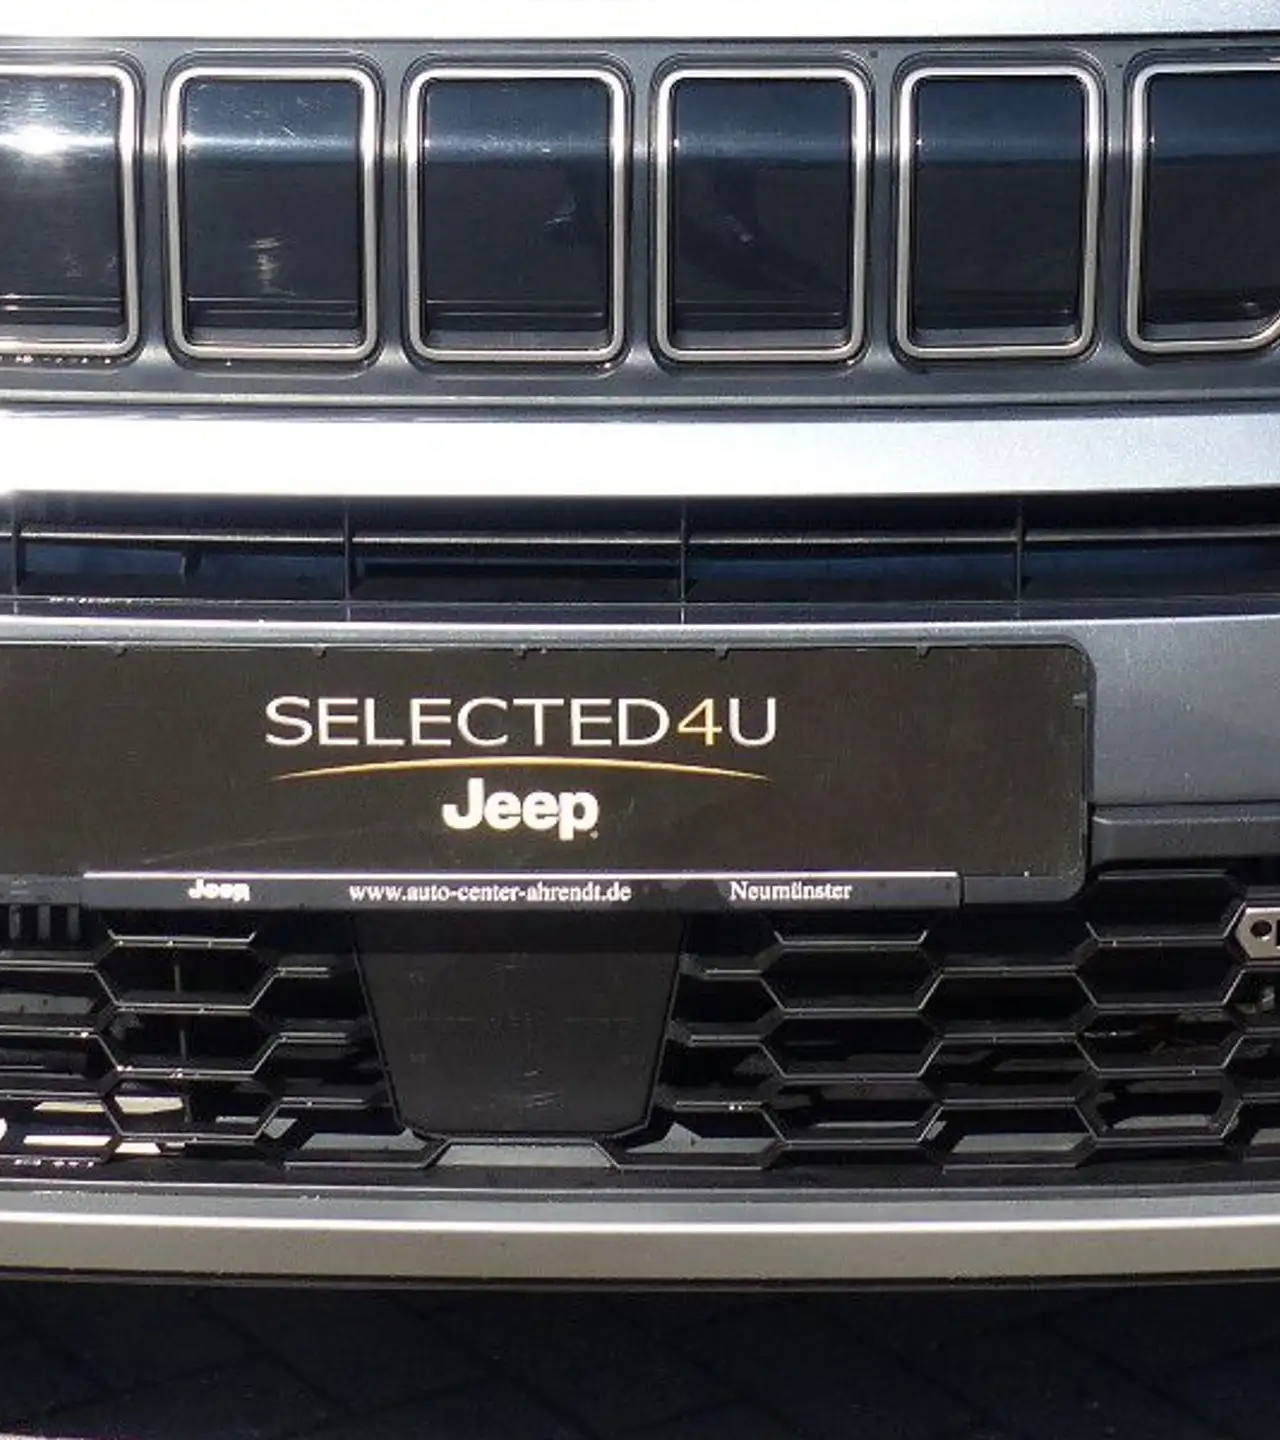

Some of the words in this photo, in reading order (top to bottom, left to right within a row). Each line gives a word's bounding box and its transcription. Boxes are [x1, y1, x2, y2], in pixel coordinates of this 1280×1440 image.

[264, 695, 778, 747] SELECTED4U
[441, 777, 599, 841] Jeep
[187, 877, 251, 902] Jeep
[348, 880, 632, 903] www.auto-center-ahrendt.de
[729, 879, 853, 901] Neumünster
